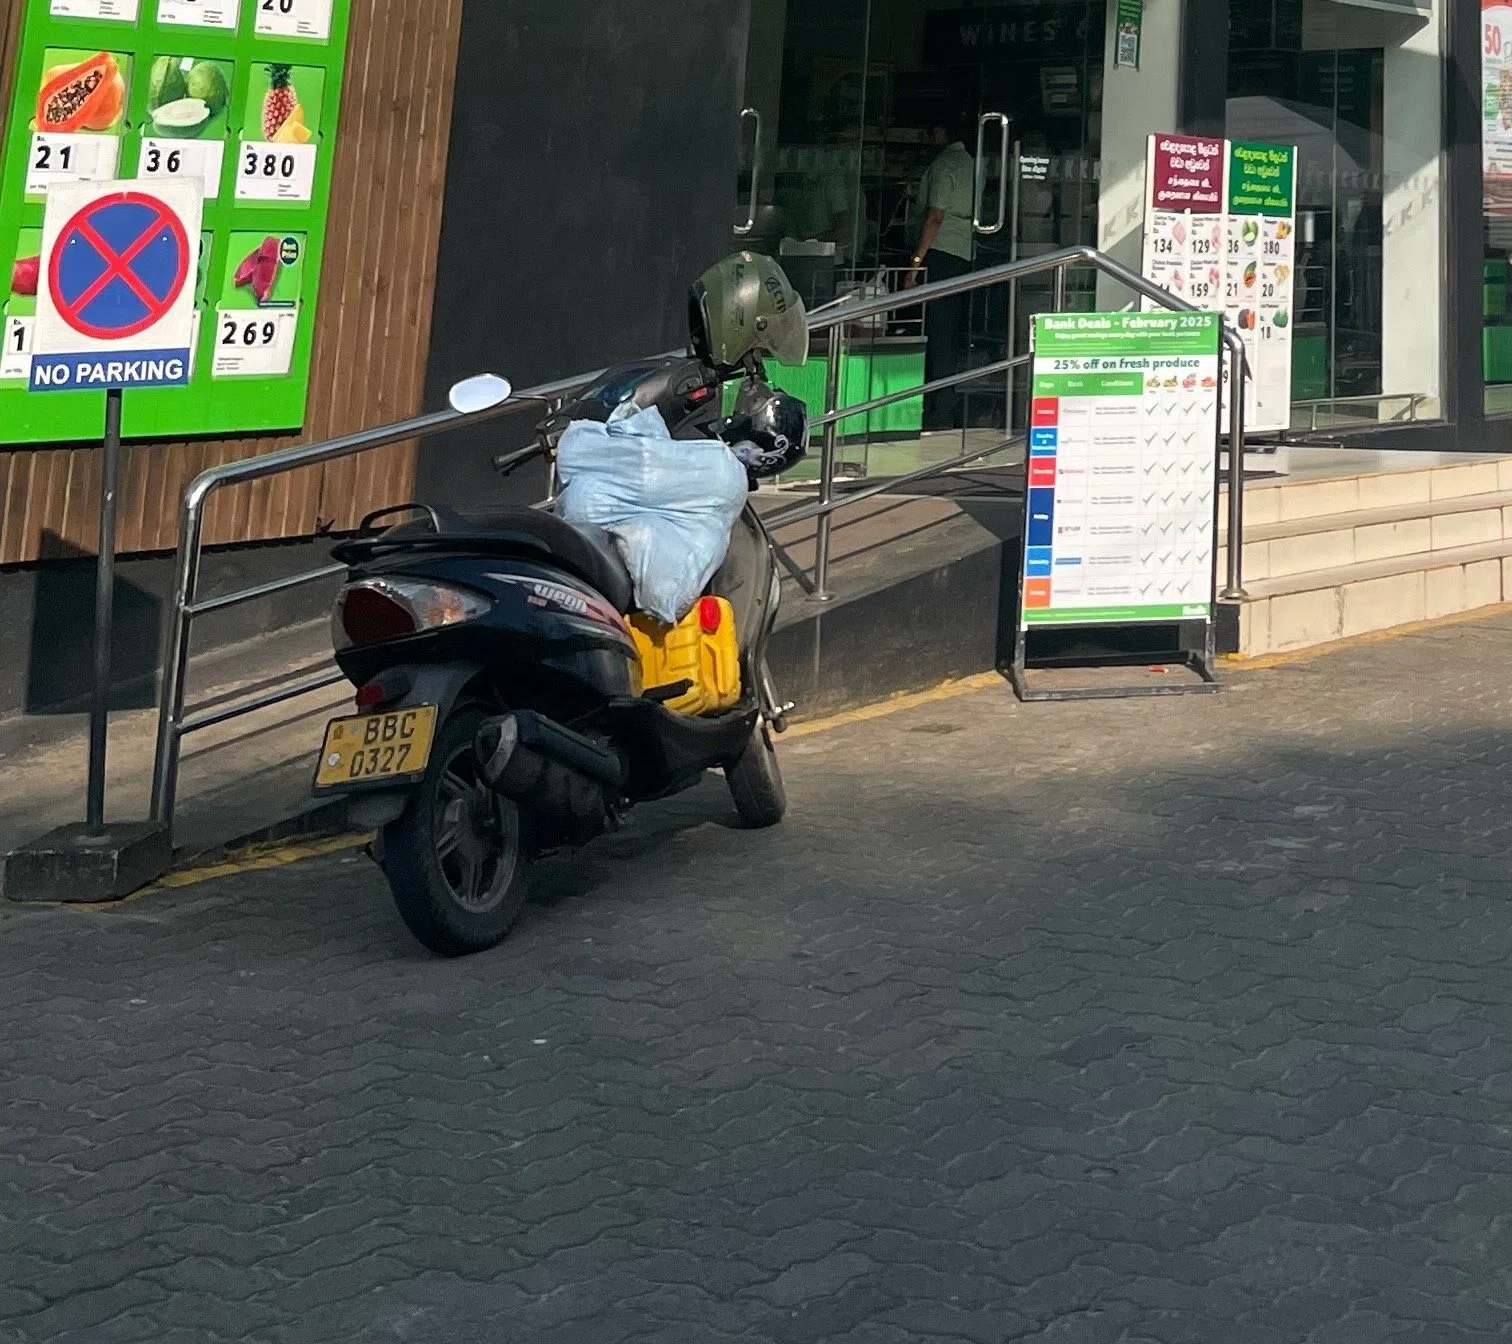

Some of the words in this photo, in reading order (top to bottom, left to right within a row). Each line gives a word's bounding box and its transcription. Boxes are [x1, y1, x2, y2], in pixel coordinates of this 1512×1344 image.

[34, 145, 72, 169] 21
[146, 149, 181, 173] 36
[244, 152, 295, 178] 380
[1153, 239, 1173, 254] 134
[1192, 239, 1210, 254] 129
[1228, 239, 1239, 253] 36
[1190, 283, 1209, 297] 159
[1226, 283, 1238, 297] 21
[1262, 284, 1274, 297] 20
[1044, 317, 1076, 330] Bank
[1077, 317, 1111, 329] Deals
[1122, 316, 1178, 330] February
[1179, 316, 1212, 327] 2025
[221, 321, 276, 346] 269
[1054, 359, 1080, 370] 25%
[1083, 358, 1101, 369] off
[1102, 360, 1116, 370] on
[1119, 357, 1149, 369] fresh
[1152, 358, 1200, 370] produce
[34, 363, 70, 386] NO
[76, 359, 183, 384] PARKING
[363, 711, 417, 745] BBC
[349, 744, 412, 778] 0327
